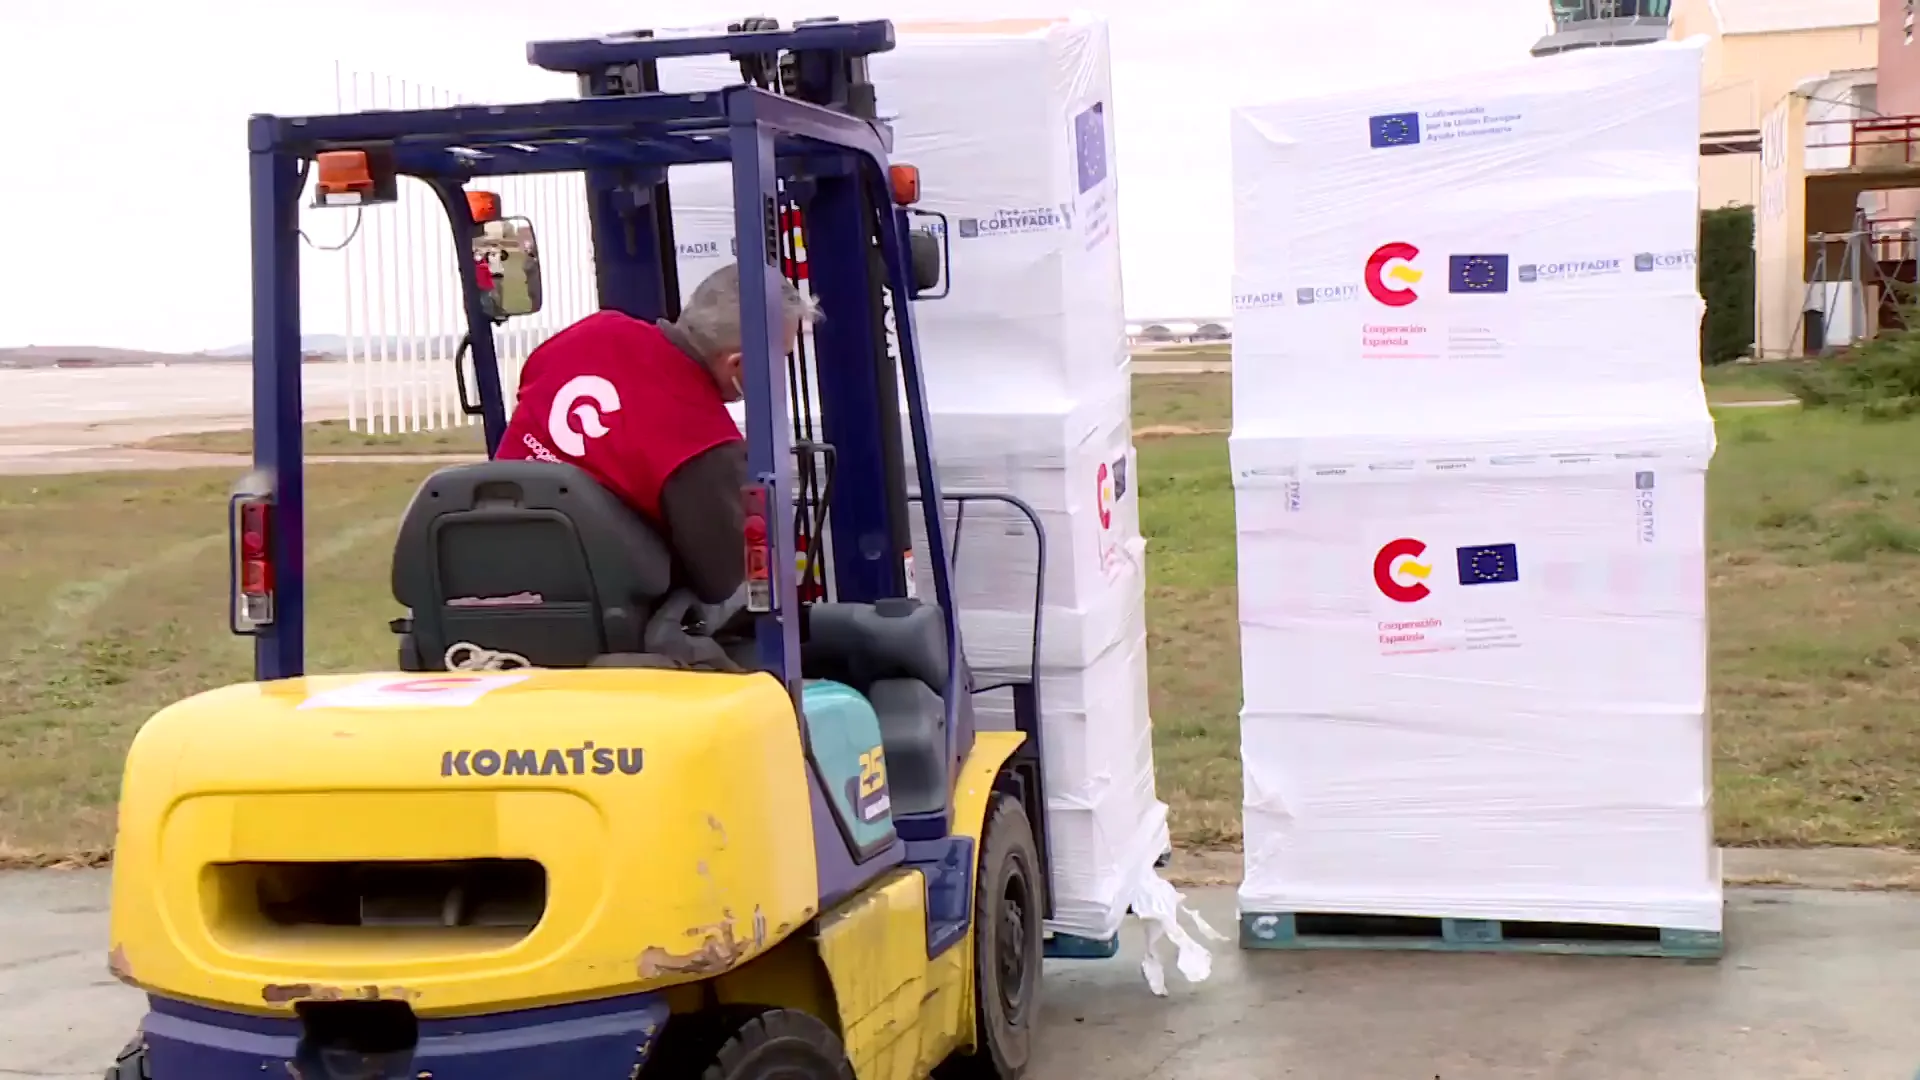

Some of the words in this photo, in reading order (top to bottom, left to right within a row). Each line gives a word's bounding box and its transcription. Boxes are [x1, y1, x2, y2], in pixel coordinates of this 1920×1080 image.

[979, 215, 1061, 231] CORTYFADER
[1537, 259, 1621, 275] CORTYFADER
[440, 740, 644, 777] KOMATSU
[859, 745, 886, 798] 25
